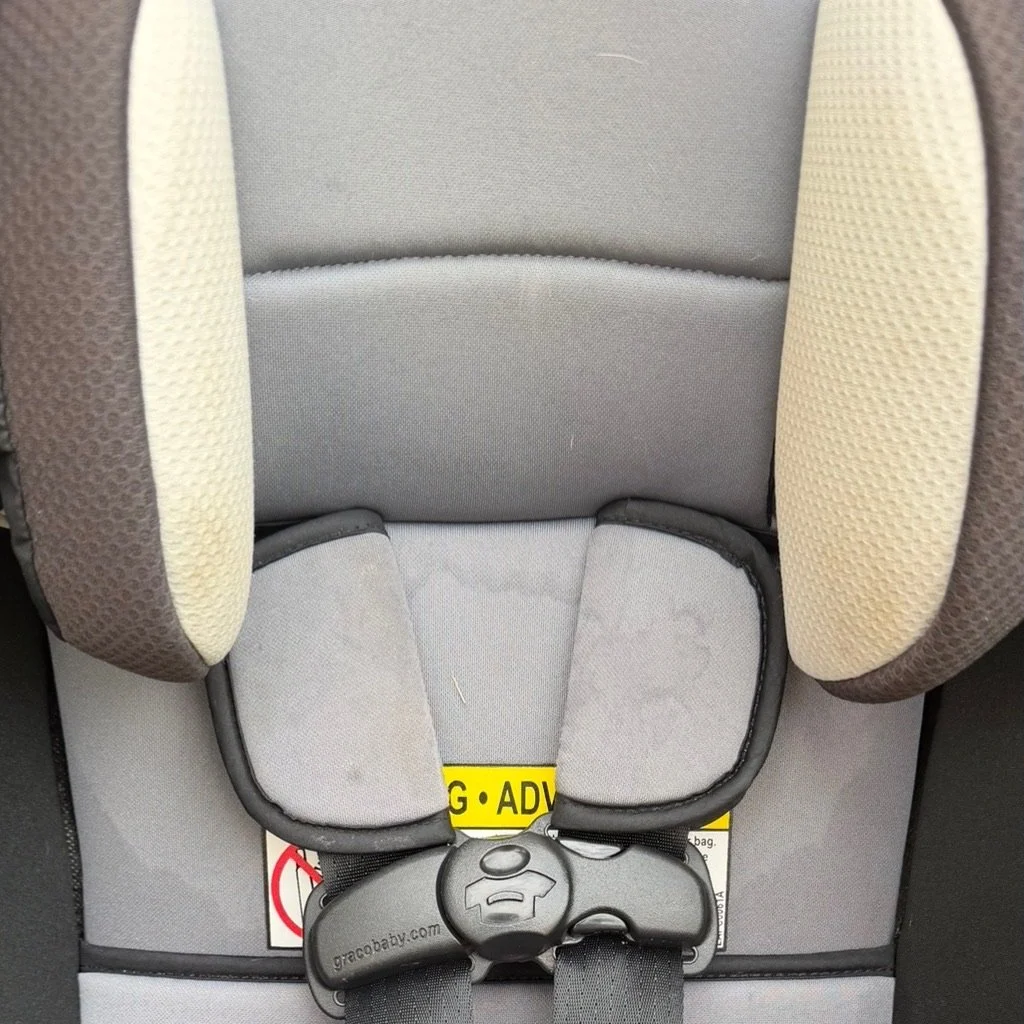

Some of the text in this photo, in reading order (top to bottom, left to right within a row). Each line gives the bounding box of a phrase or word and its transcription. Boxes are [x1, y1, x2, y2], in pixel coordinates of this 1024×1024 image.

[496, 780, 557, 815] ADV
[694, 836, 717, 849] bag.
[333, 923, 441, 972] gracobaby.com
